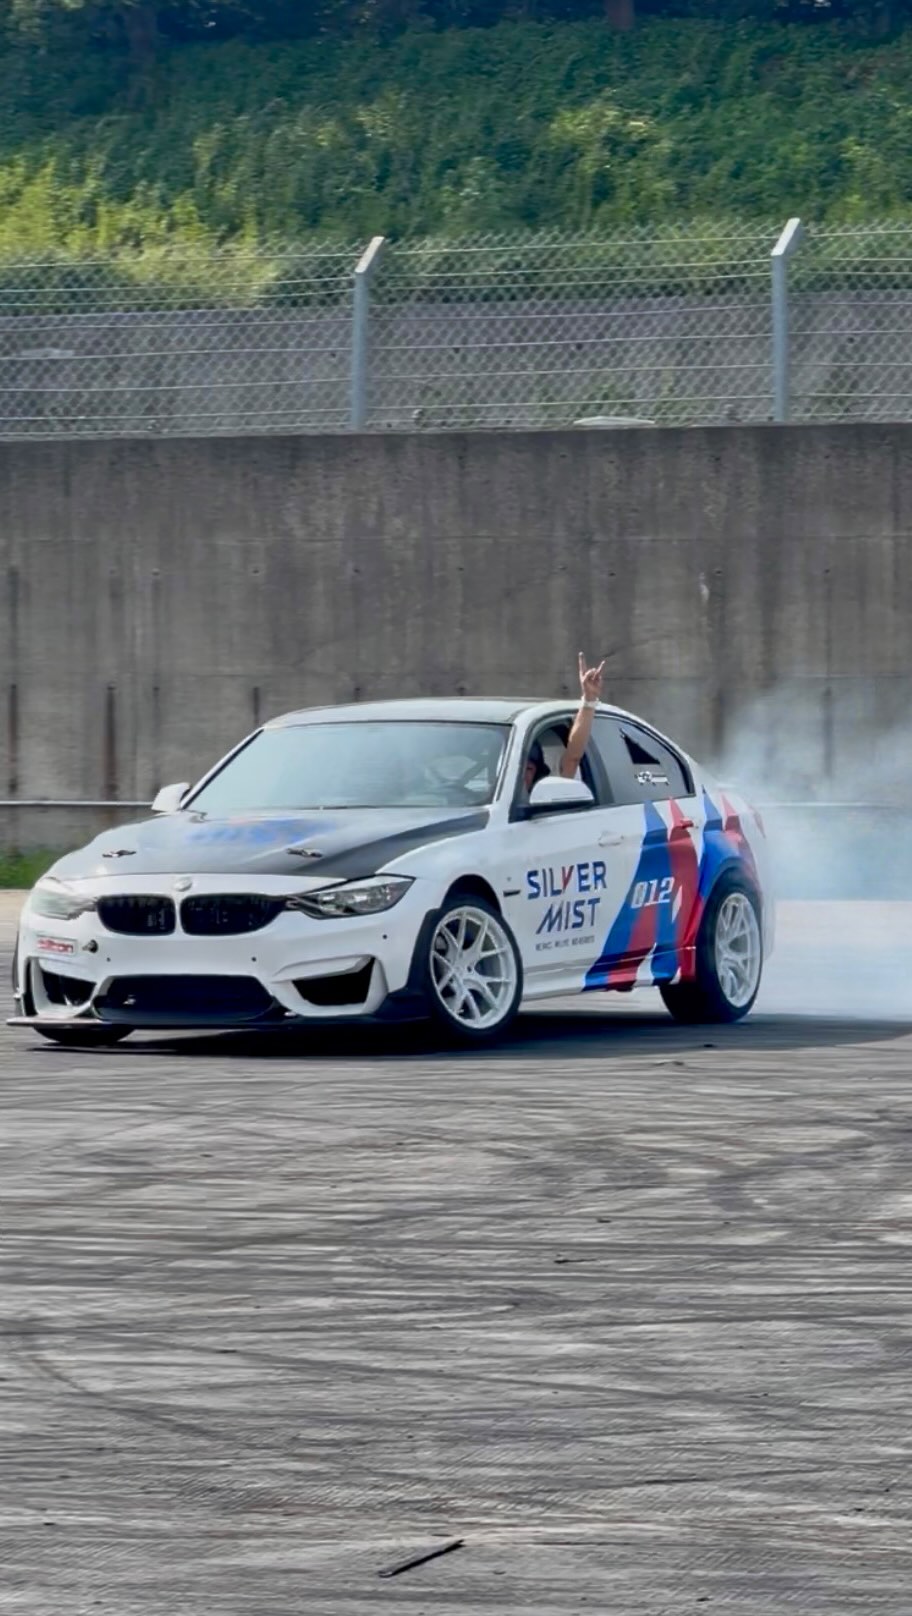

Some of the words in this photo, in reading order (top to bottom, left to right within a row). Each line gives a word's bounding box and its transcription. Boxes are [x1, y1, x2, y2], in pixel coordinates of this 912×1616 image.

[527, 861, 607, 900] SILVER
[631, 876, 675, 909] 012
[536, 897, 601, 935] MIST
